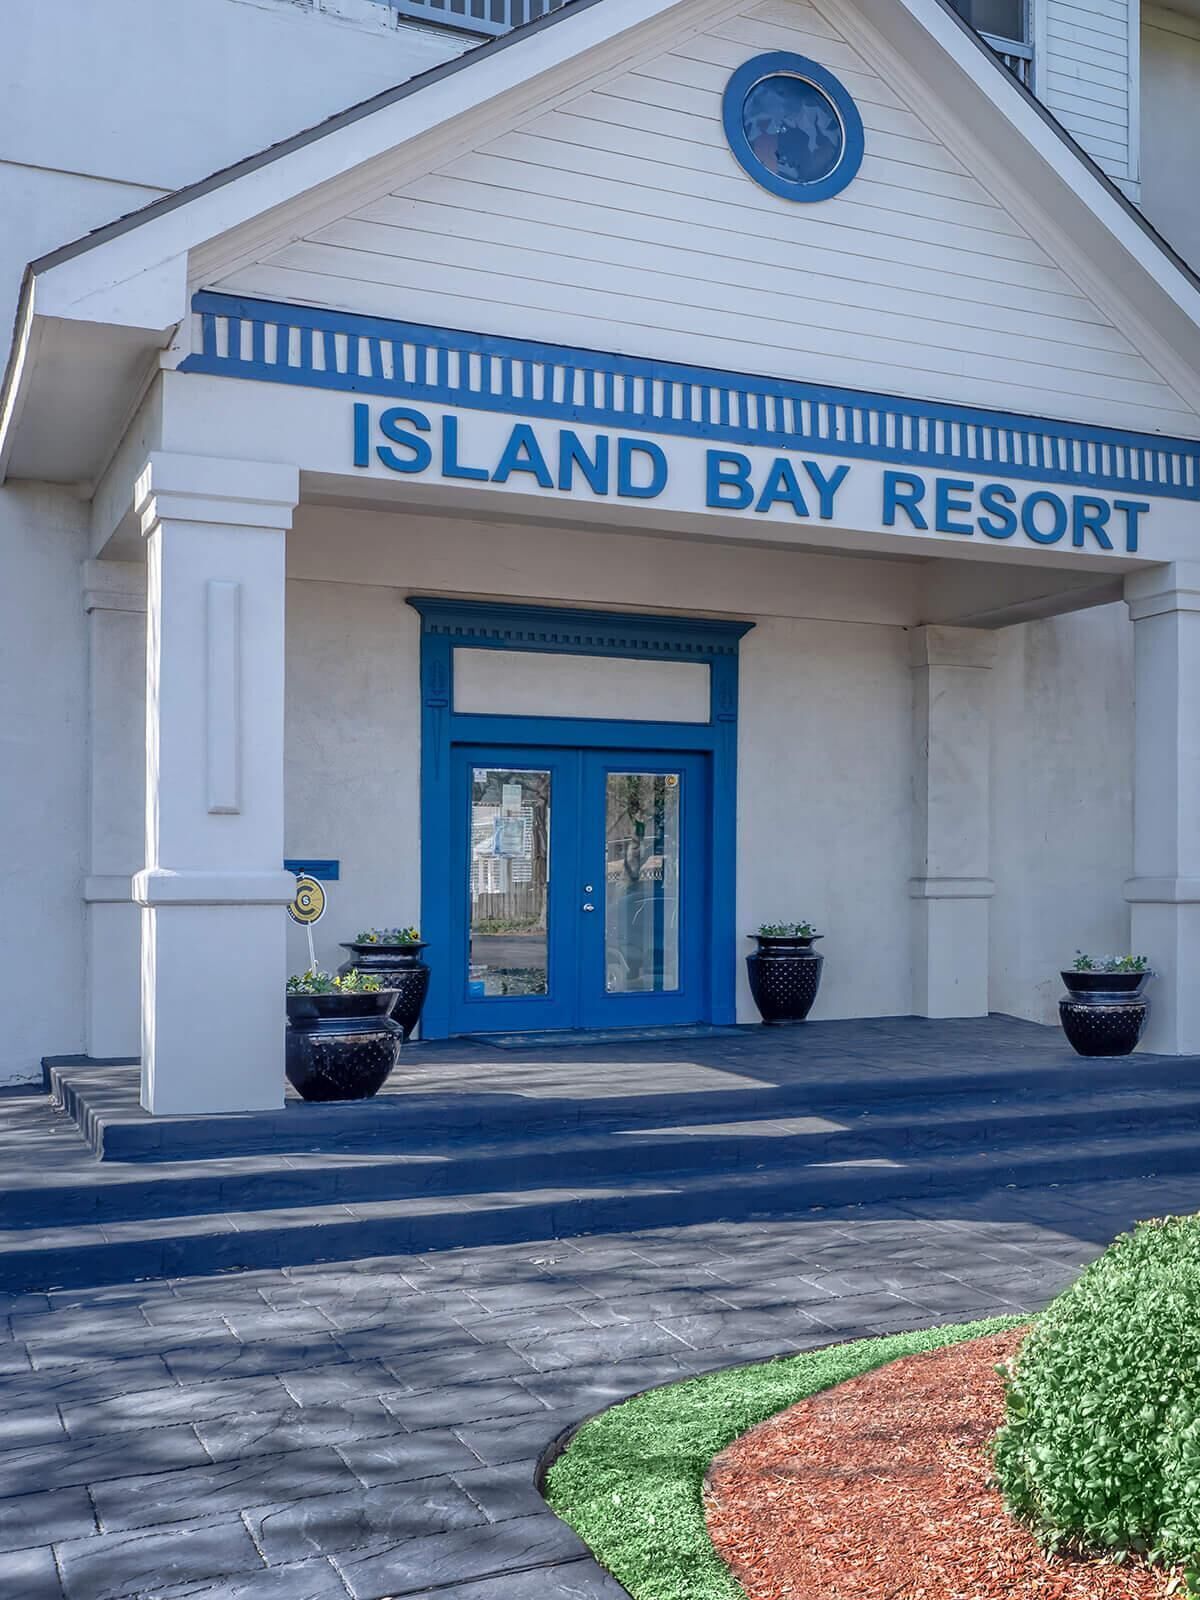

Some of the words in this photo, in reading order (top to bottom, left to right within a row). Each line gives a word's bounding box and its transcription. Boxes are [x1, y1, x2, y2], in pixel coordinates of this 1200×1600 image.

[352, 400, 669, 499] ISLAND
[704, 447, 852, 520] BAY
[880, 469, 1152, 553] RESORT
